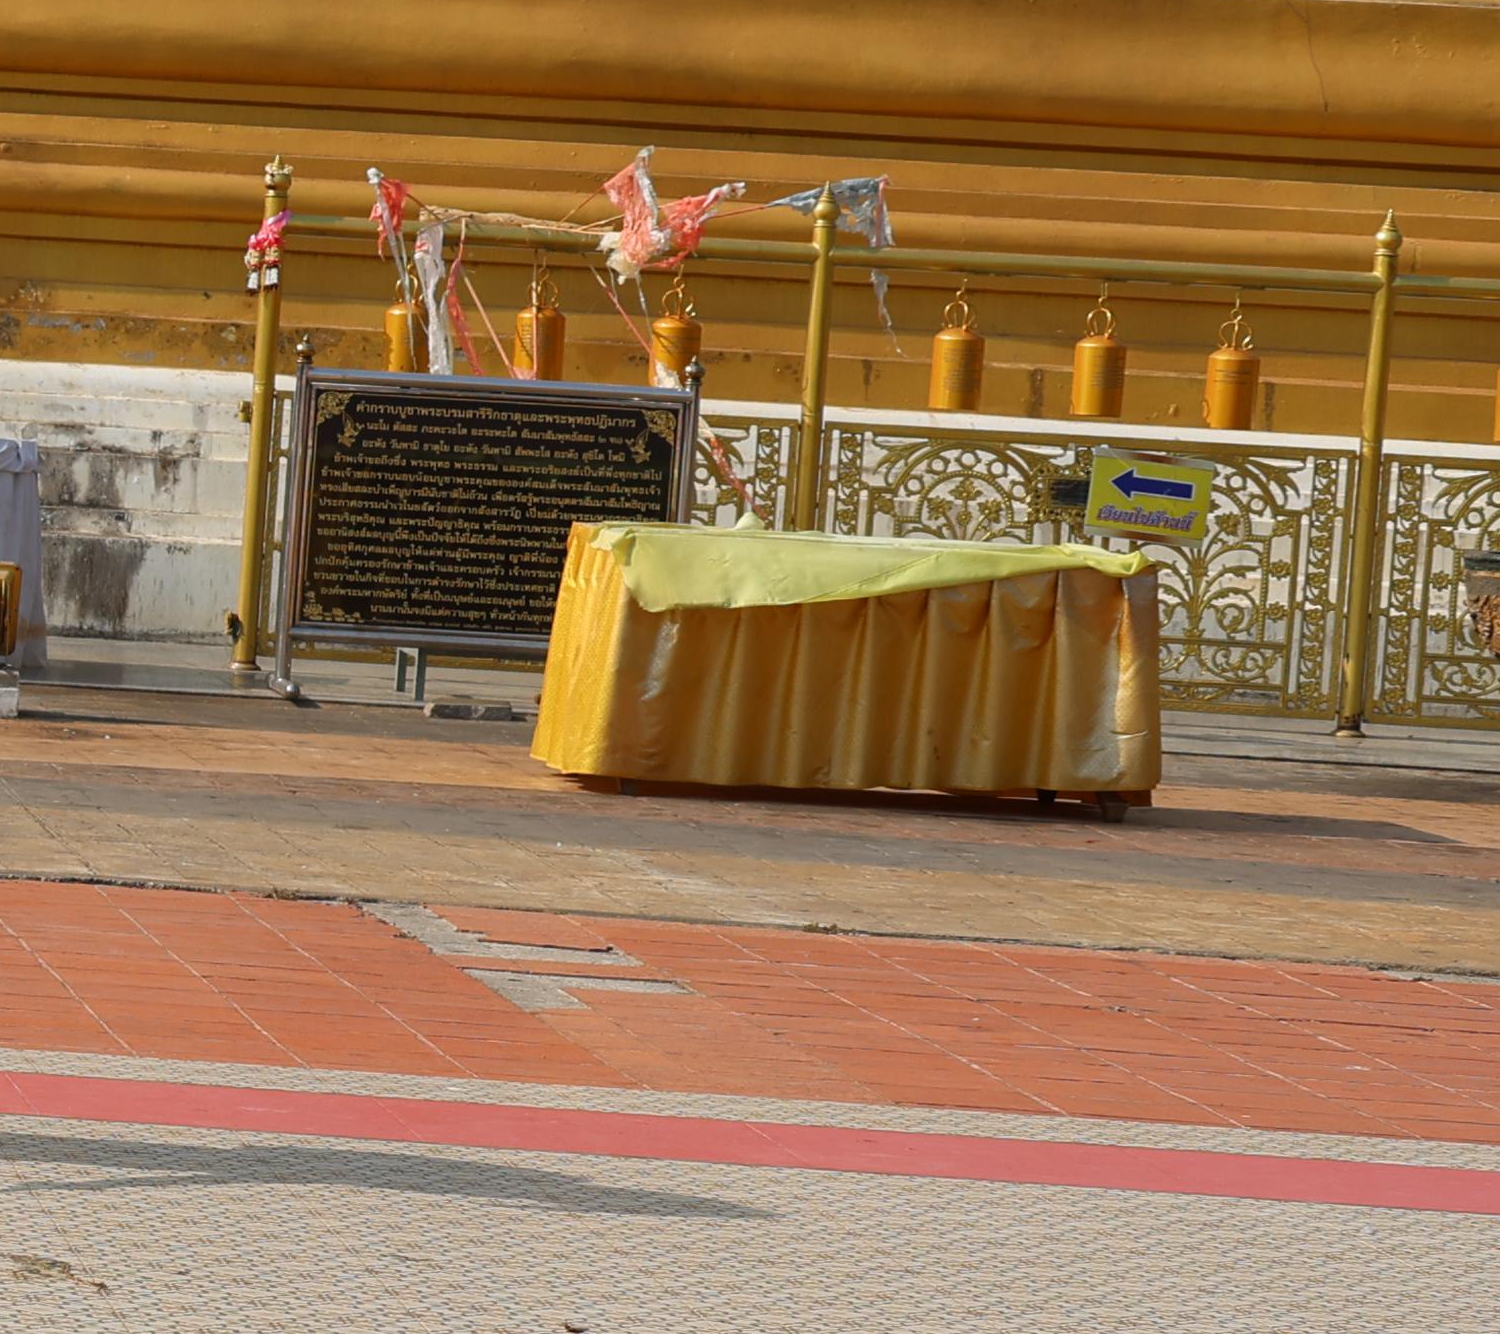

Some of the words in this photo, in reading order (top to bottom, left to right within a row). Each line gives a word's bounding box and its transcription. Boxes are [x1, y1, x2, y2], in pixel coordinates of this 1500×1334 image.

[1097, 503, 1199, 532] เวียนไปด้านนี้
